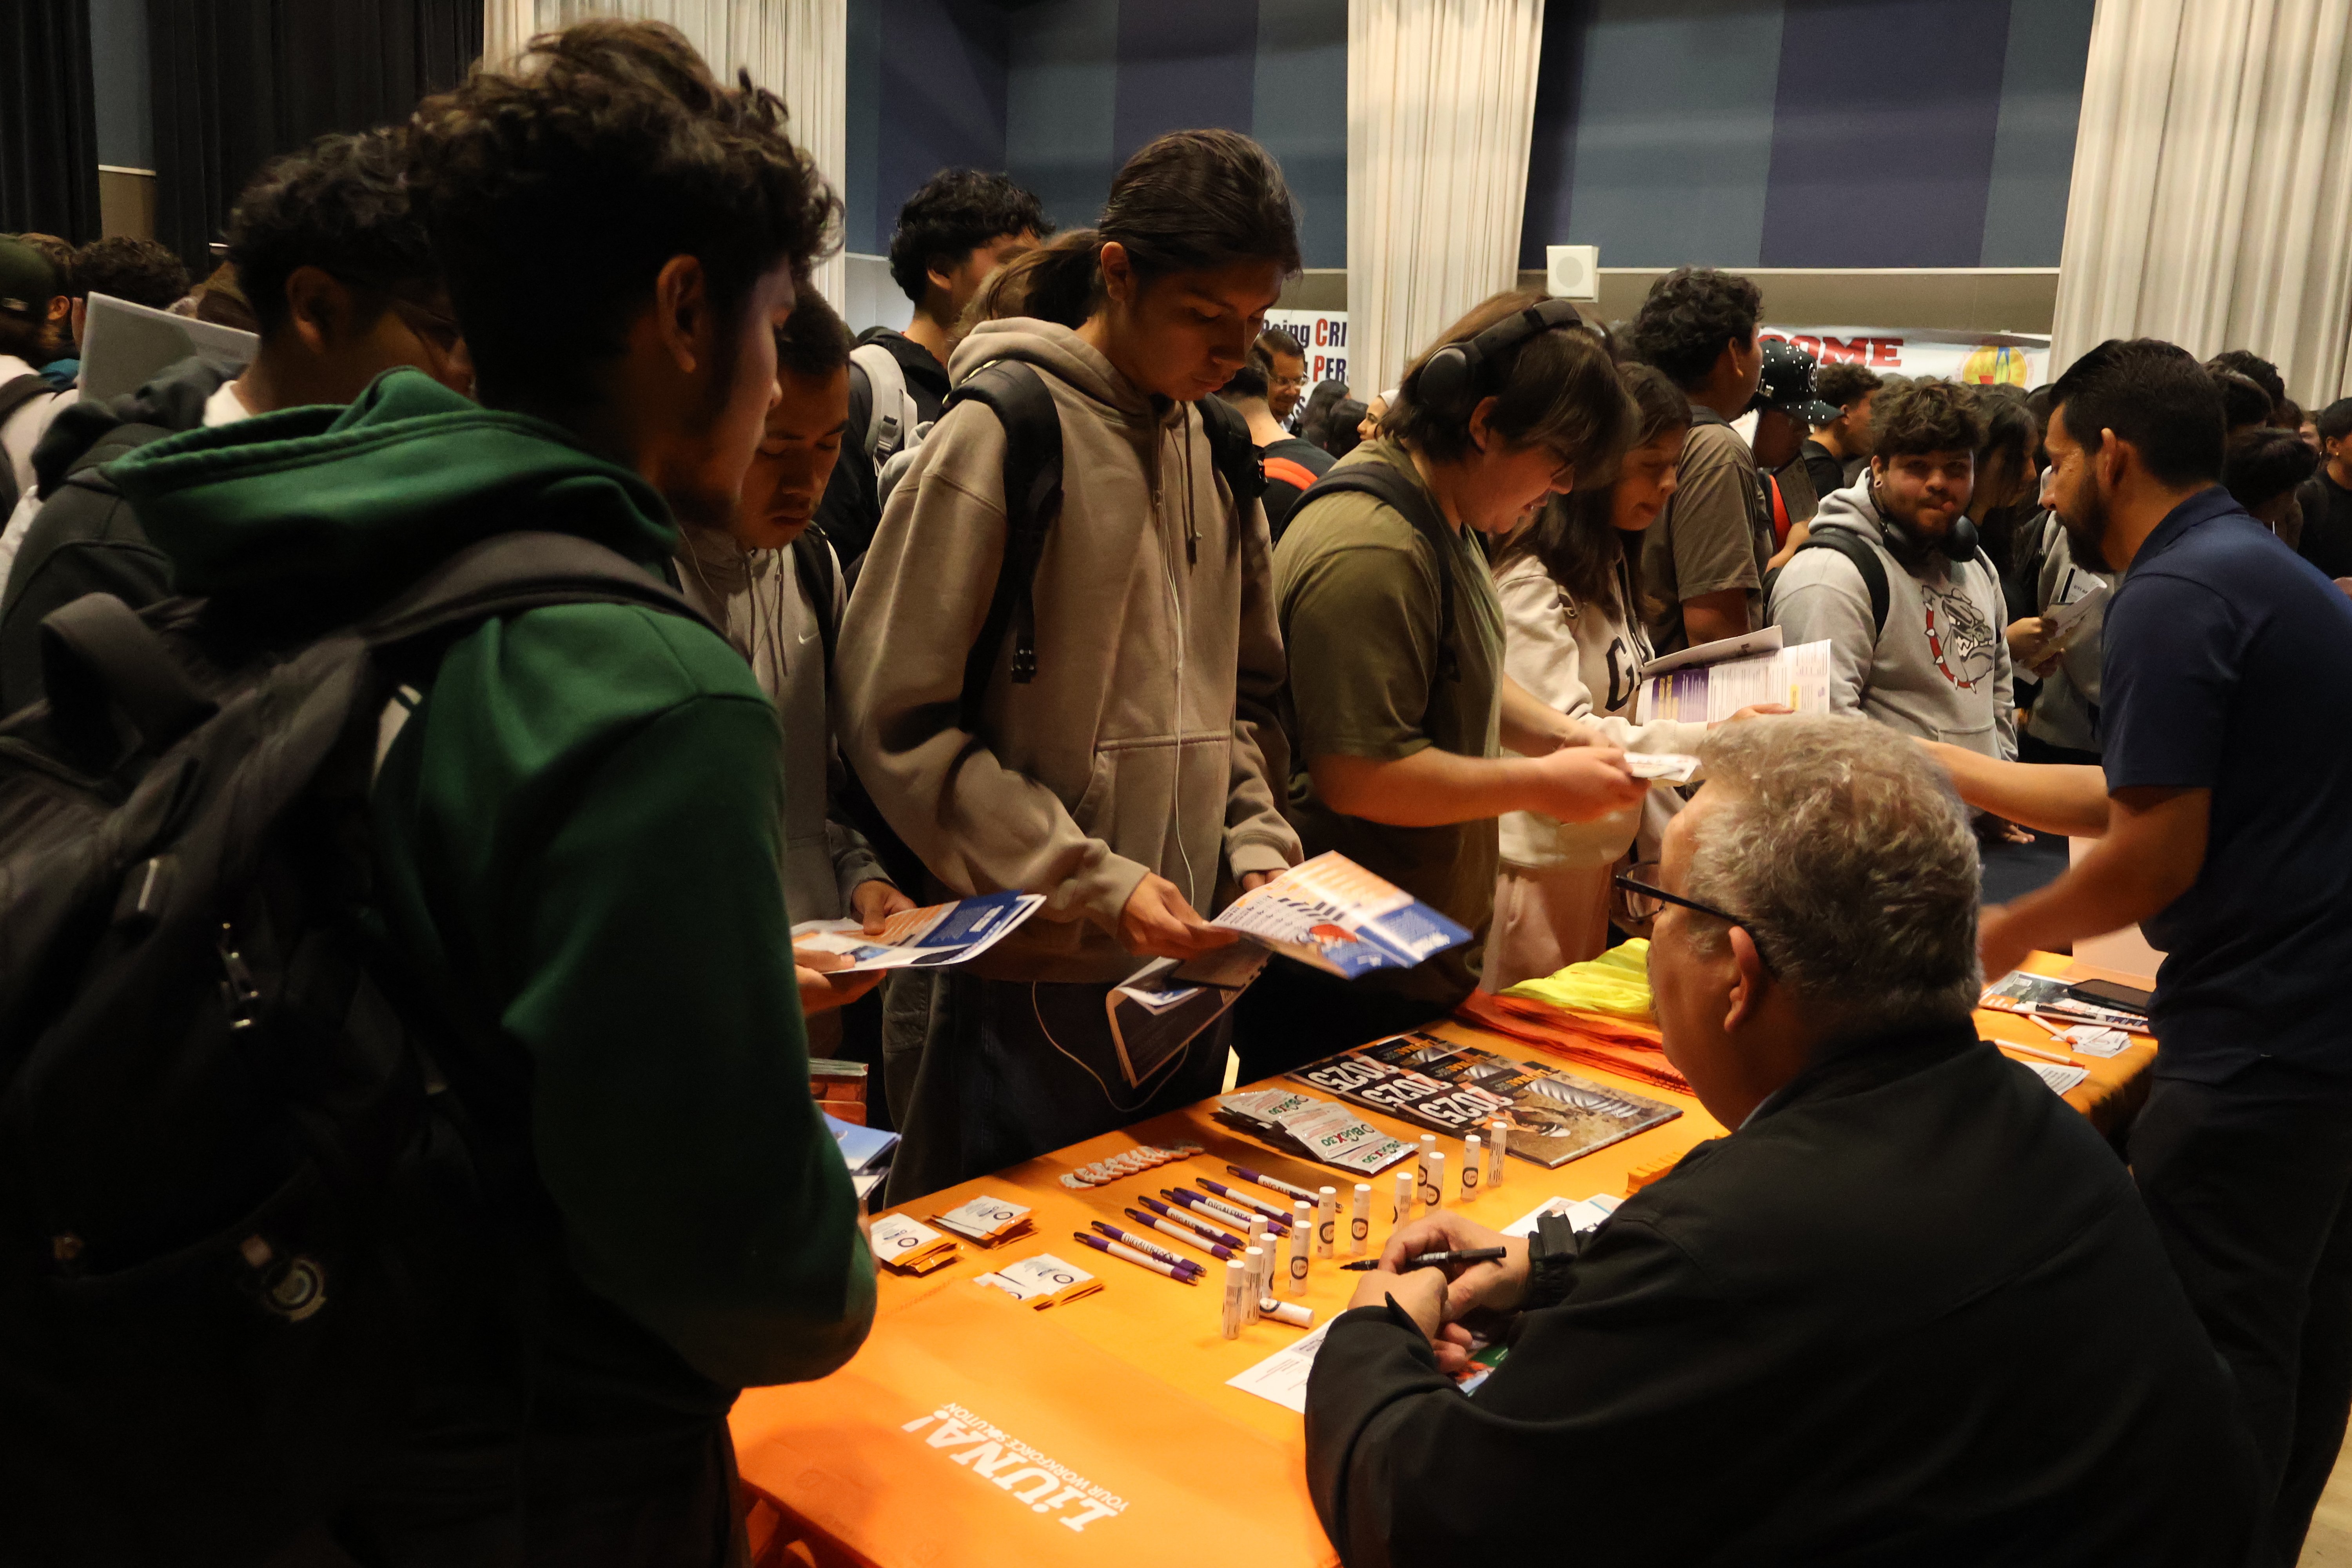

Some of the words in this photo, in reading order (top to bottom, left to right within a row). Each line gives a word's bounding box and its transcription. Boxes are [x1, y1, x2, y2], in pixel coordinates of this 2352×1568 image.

[1758, 334, 1904, 367] OME
[1313, 355, 1348, 384] PER
[1308, 1056, 1400, 1093] 2025
[1361, 1073, 1453, 1107] 2025
[1418, 1086, 1513, 1123] 2025
[944, 1402, 1011, 1442] SOLUTION
[1005, 1438, 1091, 1490] WORKFORCE
[1087, 1485, 1129, 1512] YOUR
